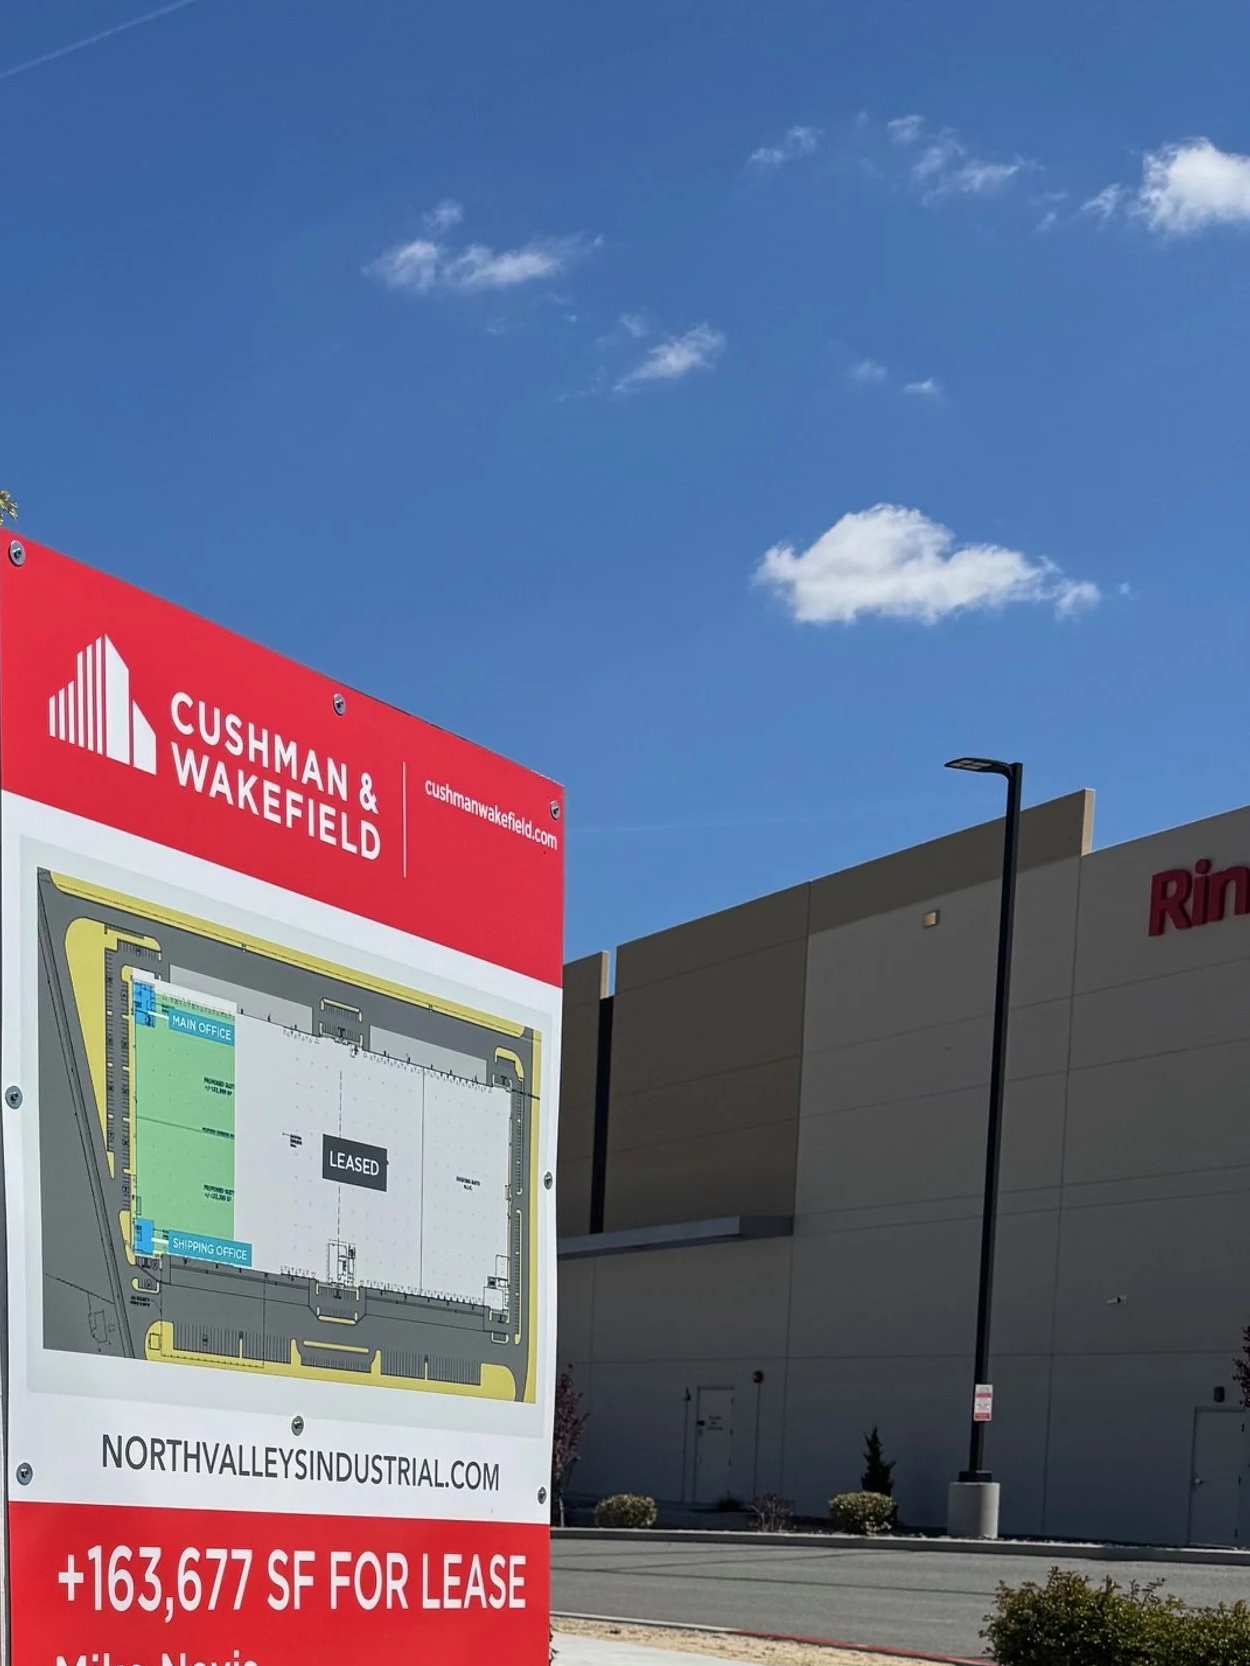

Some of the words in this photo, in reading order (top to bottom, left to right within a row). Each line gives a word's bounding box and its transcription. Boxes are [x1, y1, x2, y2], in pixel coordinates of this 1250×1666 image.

[170, 691, 348, 802] CUSHMAN
[359, 772, 379, 814] &
[172, 741, 380, 860] WAKEFIELD
[425, 779, 557, 850] cushmanwakefield.com
[173, 1016, 196, 1030] MAIN
[199, 1023, 231, 1040] OFFICE
[330, 1150, 379, 1176] LEASED
[173, 1238, 213, 1254] SHIPPING
[216, 1246, 247, 1260] OFFICE
[102, 1434, 499, 1492] NORTHVALLEYSINDUSTRIAL.COM
[59, 1545, 252, 1622] +163,677
[268, 1550, 315, 1610] SF
[331, 1552, 408, 1609] FOR
[423, 1555, 525, 1609] LEASE
